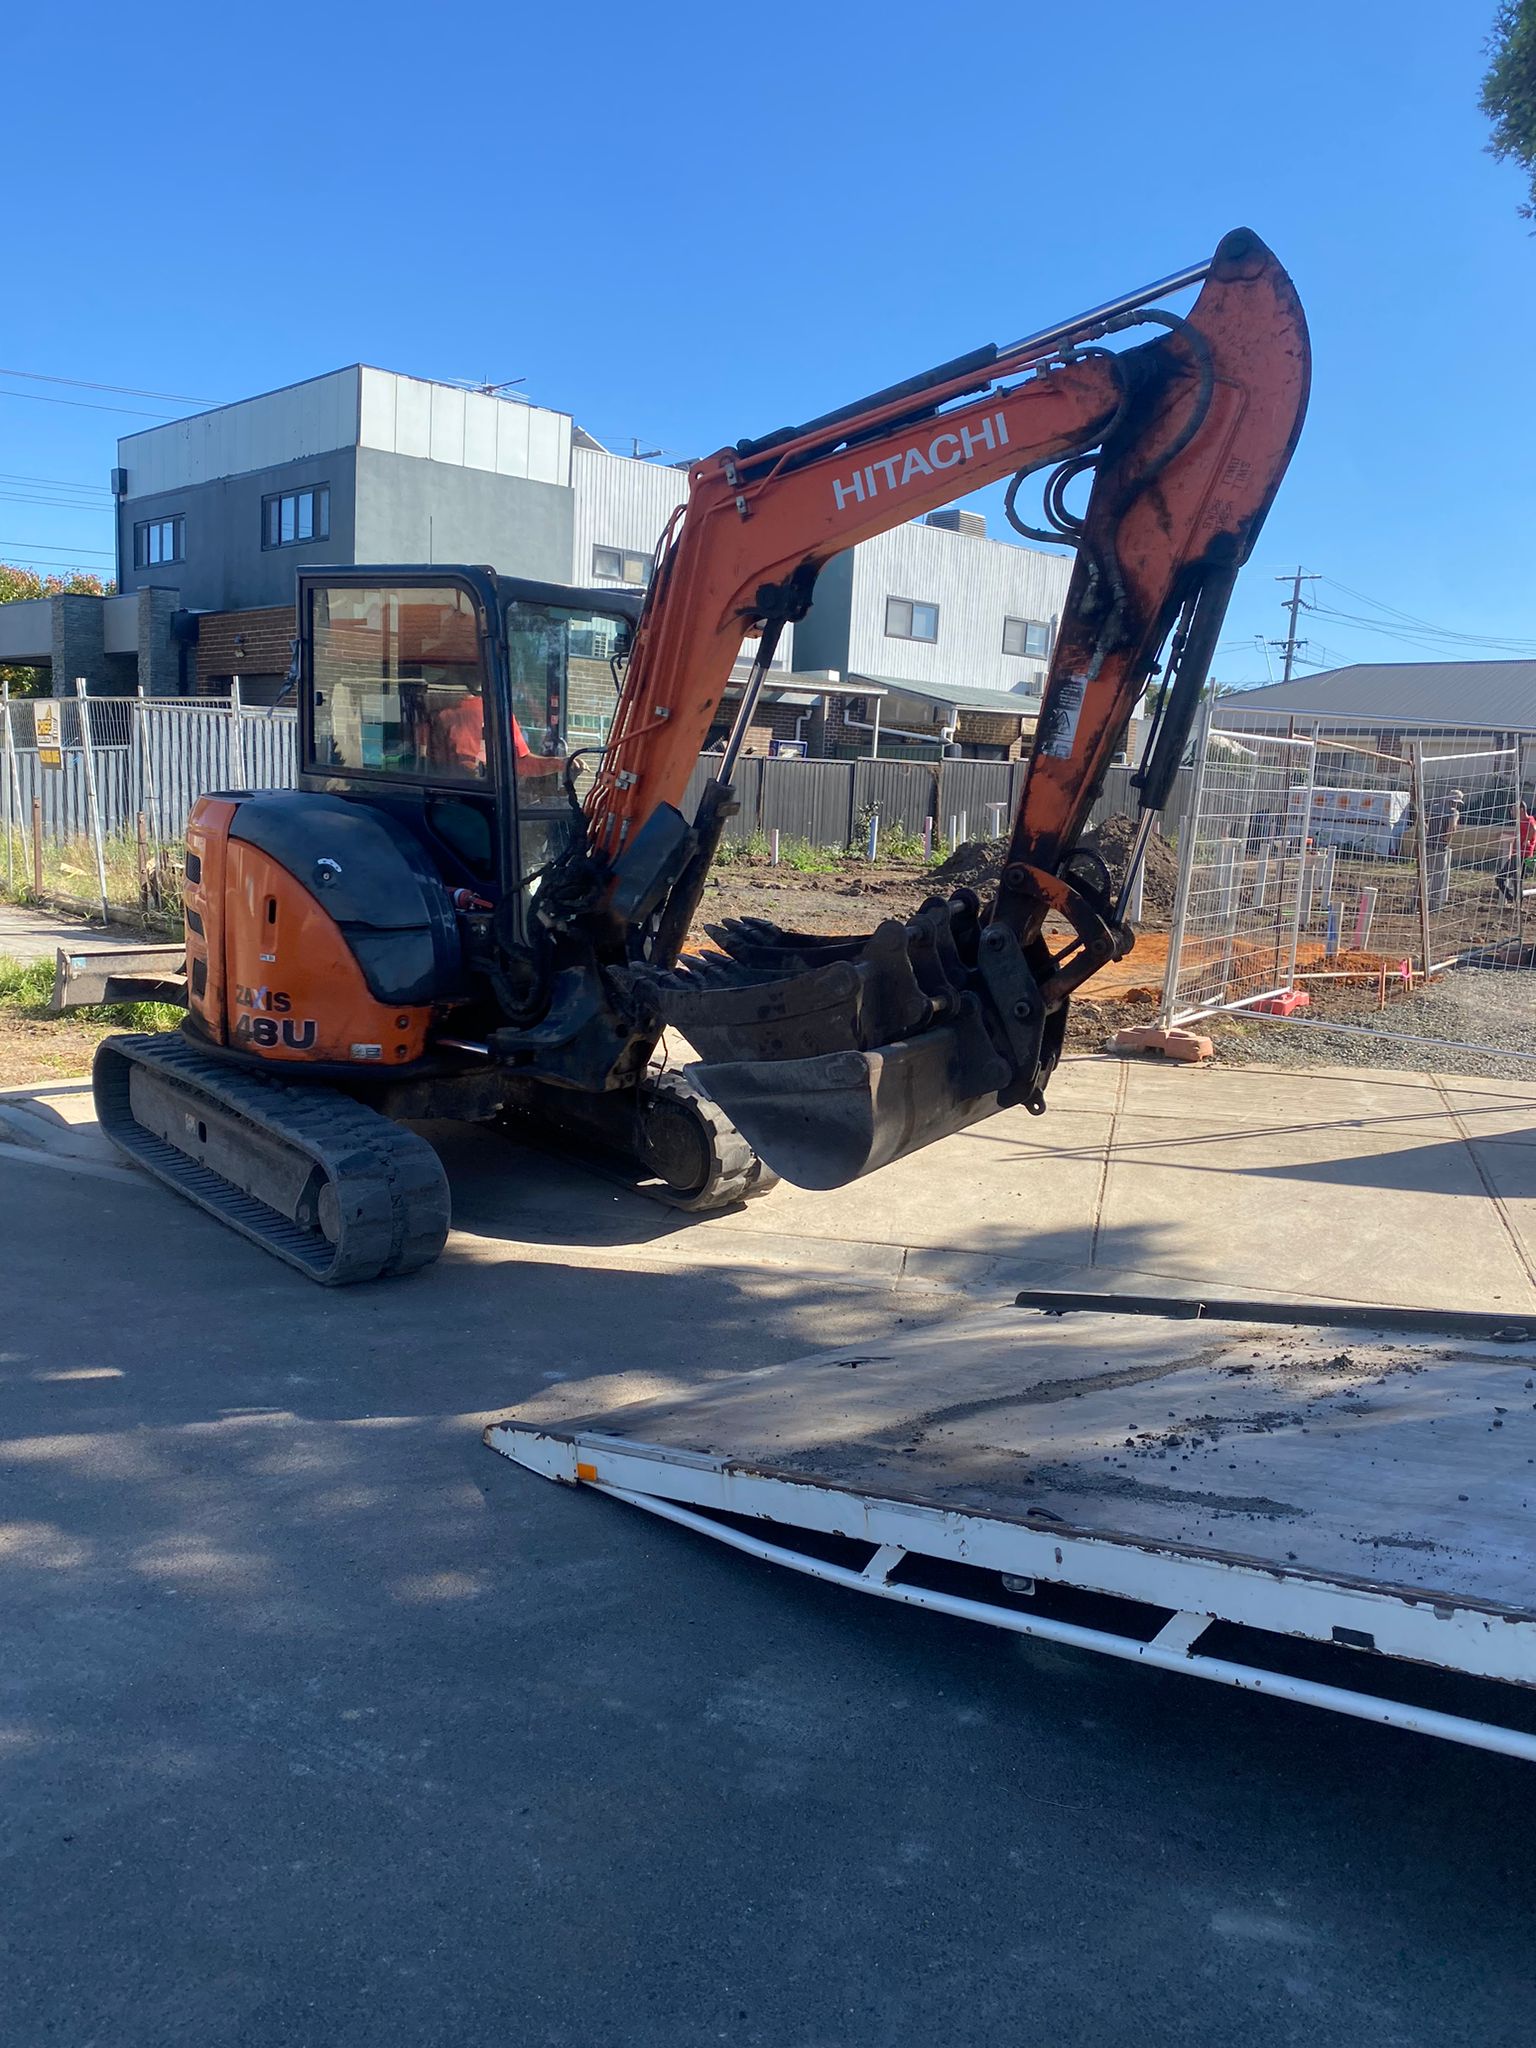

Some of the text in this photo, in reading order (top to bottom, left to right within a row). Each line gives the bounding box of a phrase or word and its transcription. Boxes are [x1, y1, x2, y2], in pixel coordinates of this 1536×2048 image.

[832, 412, 1009, 510] HITACHI
[235, 984, 292, 1013] ZAXIS
[236, 1013, 317, 1049] 48U
